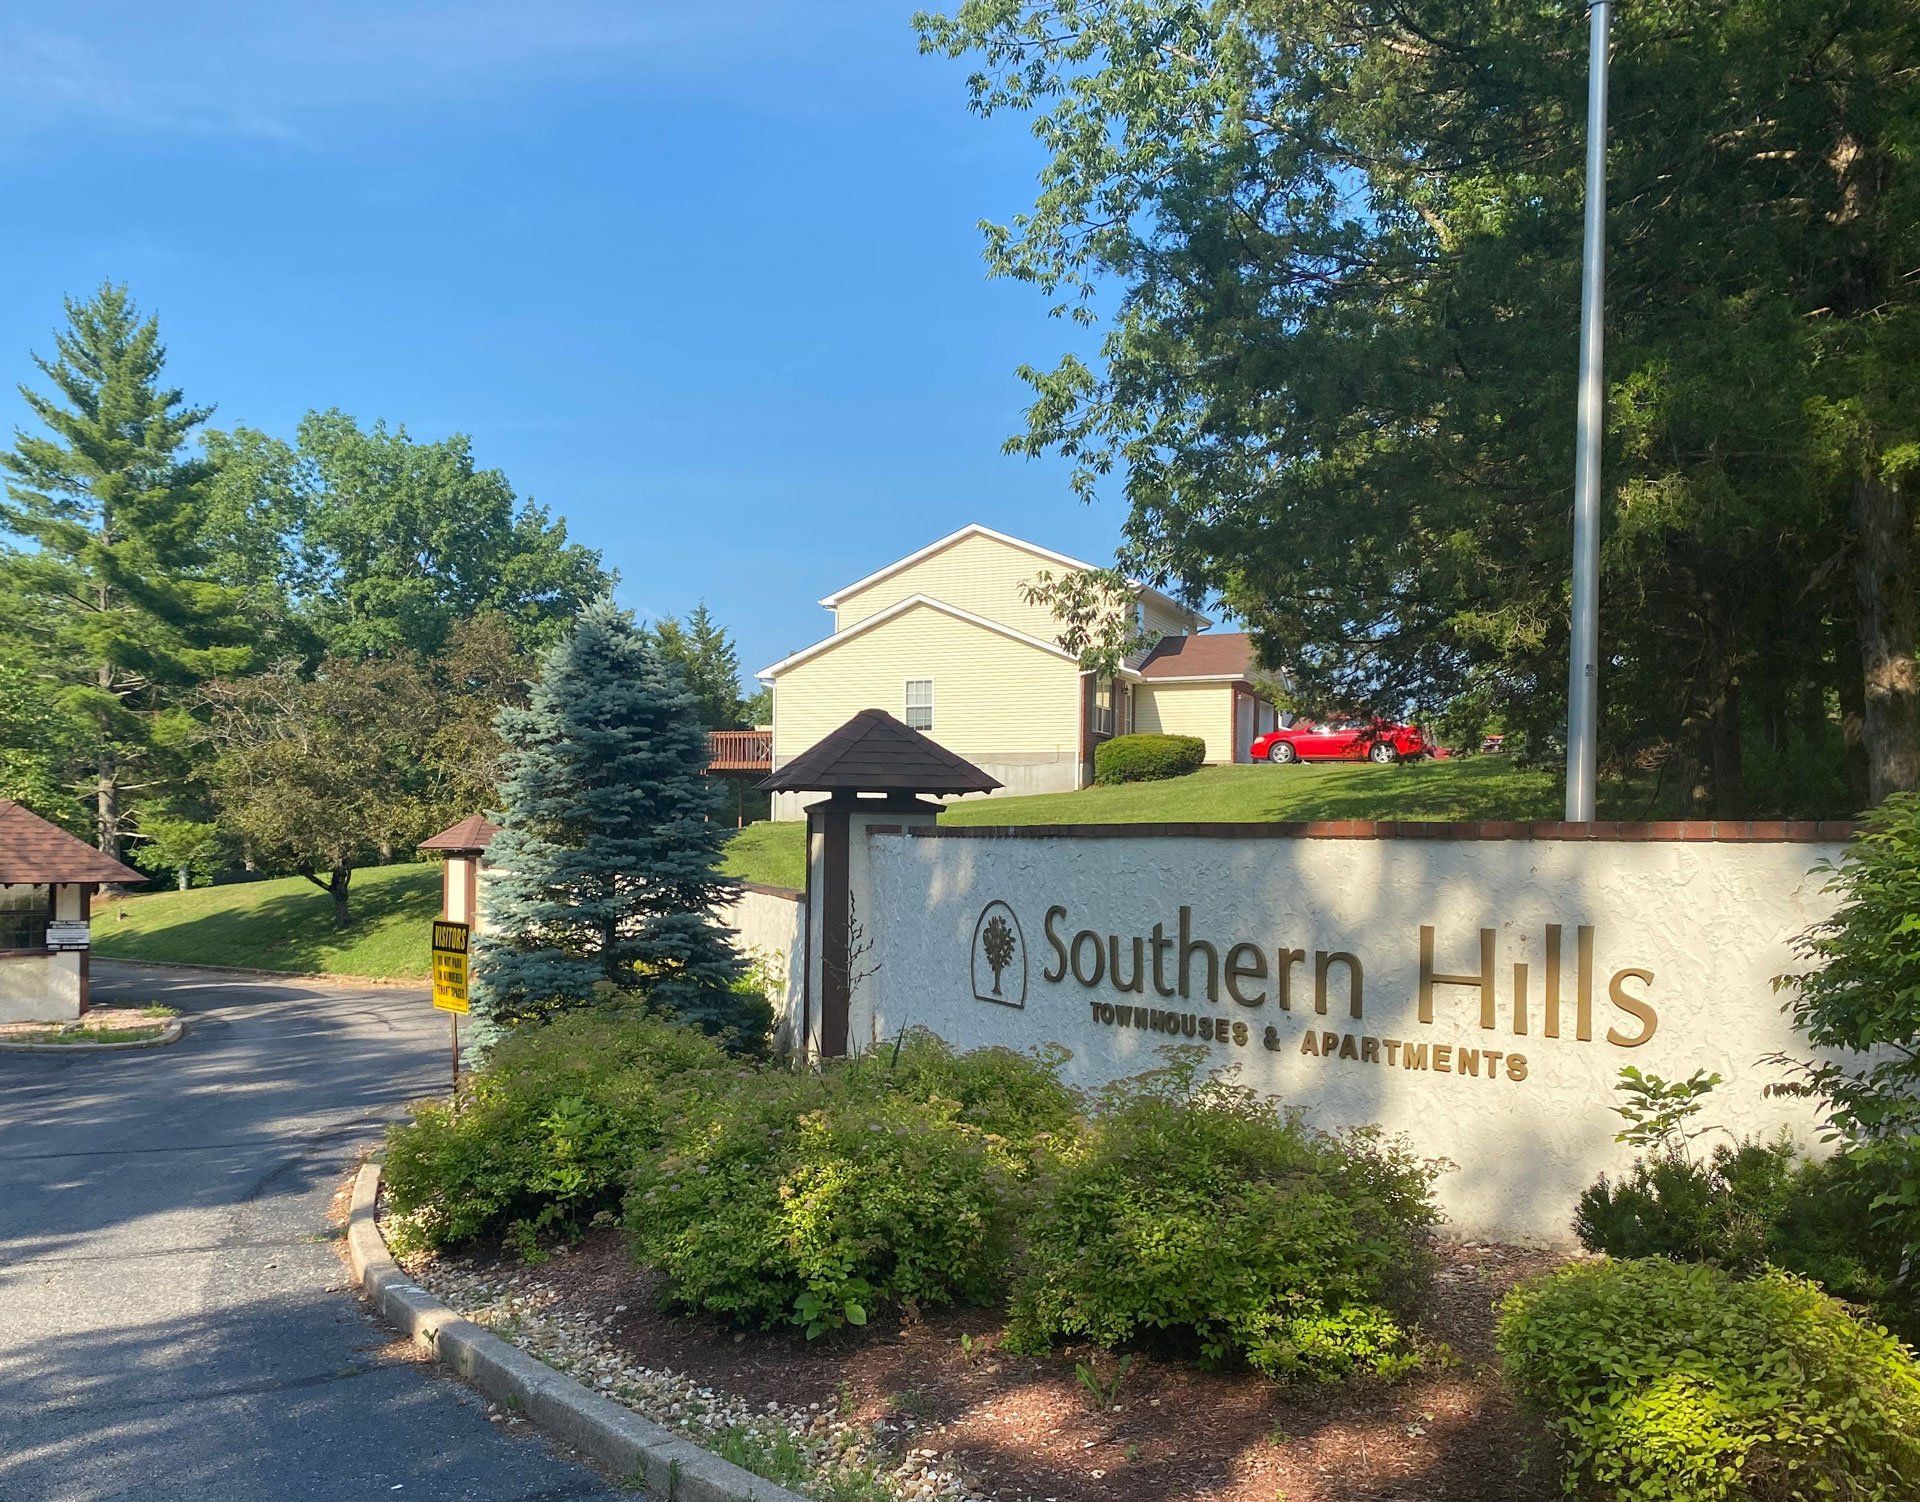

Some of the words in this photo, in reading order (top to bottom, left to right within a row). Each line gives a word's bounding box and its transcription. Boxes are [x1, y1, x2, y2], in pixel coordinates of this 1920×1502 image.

[435, 925, 467, 951] VISITORS
[1043, 905, 1364, 1019] Southern
[1418, 923, 1659, 1048] Hills
[1090, 1001, 1249, 1046] TOWNHOUSES
[1264, 1025, 1281, 1052] &
[1301, 1030, 1529, 1081] APARTMENTS
